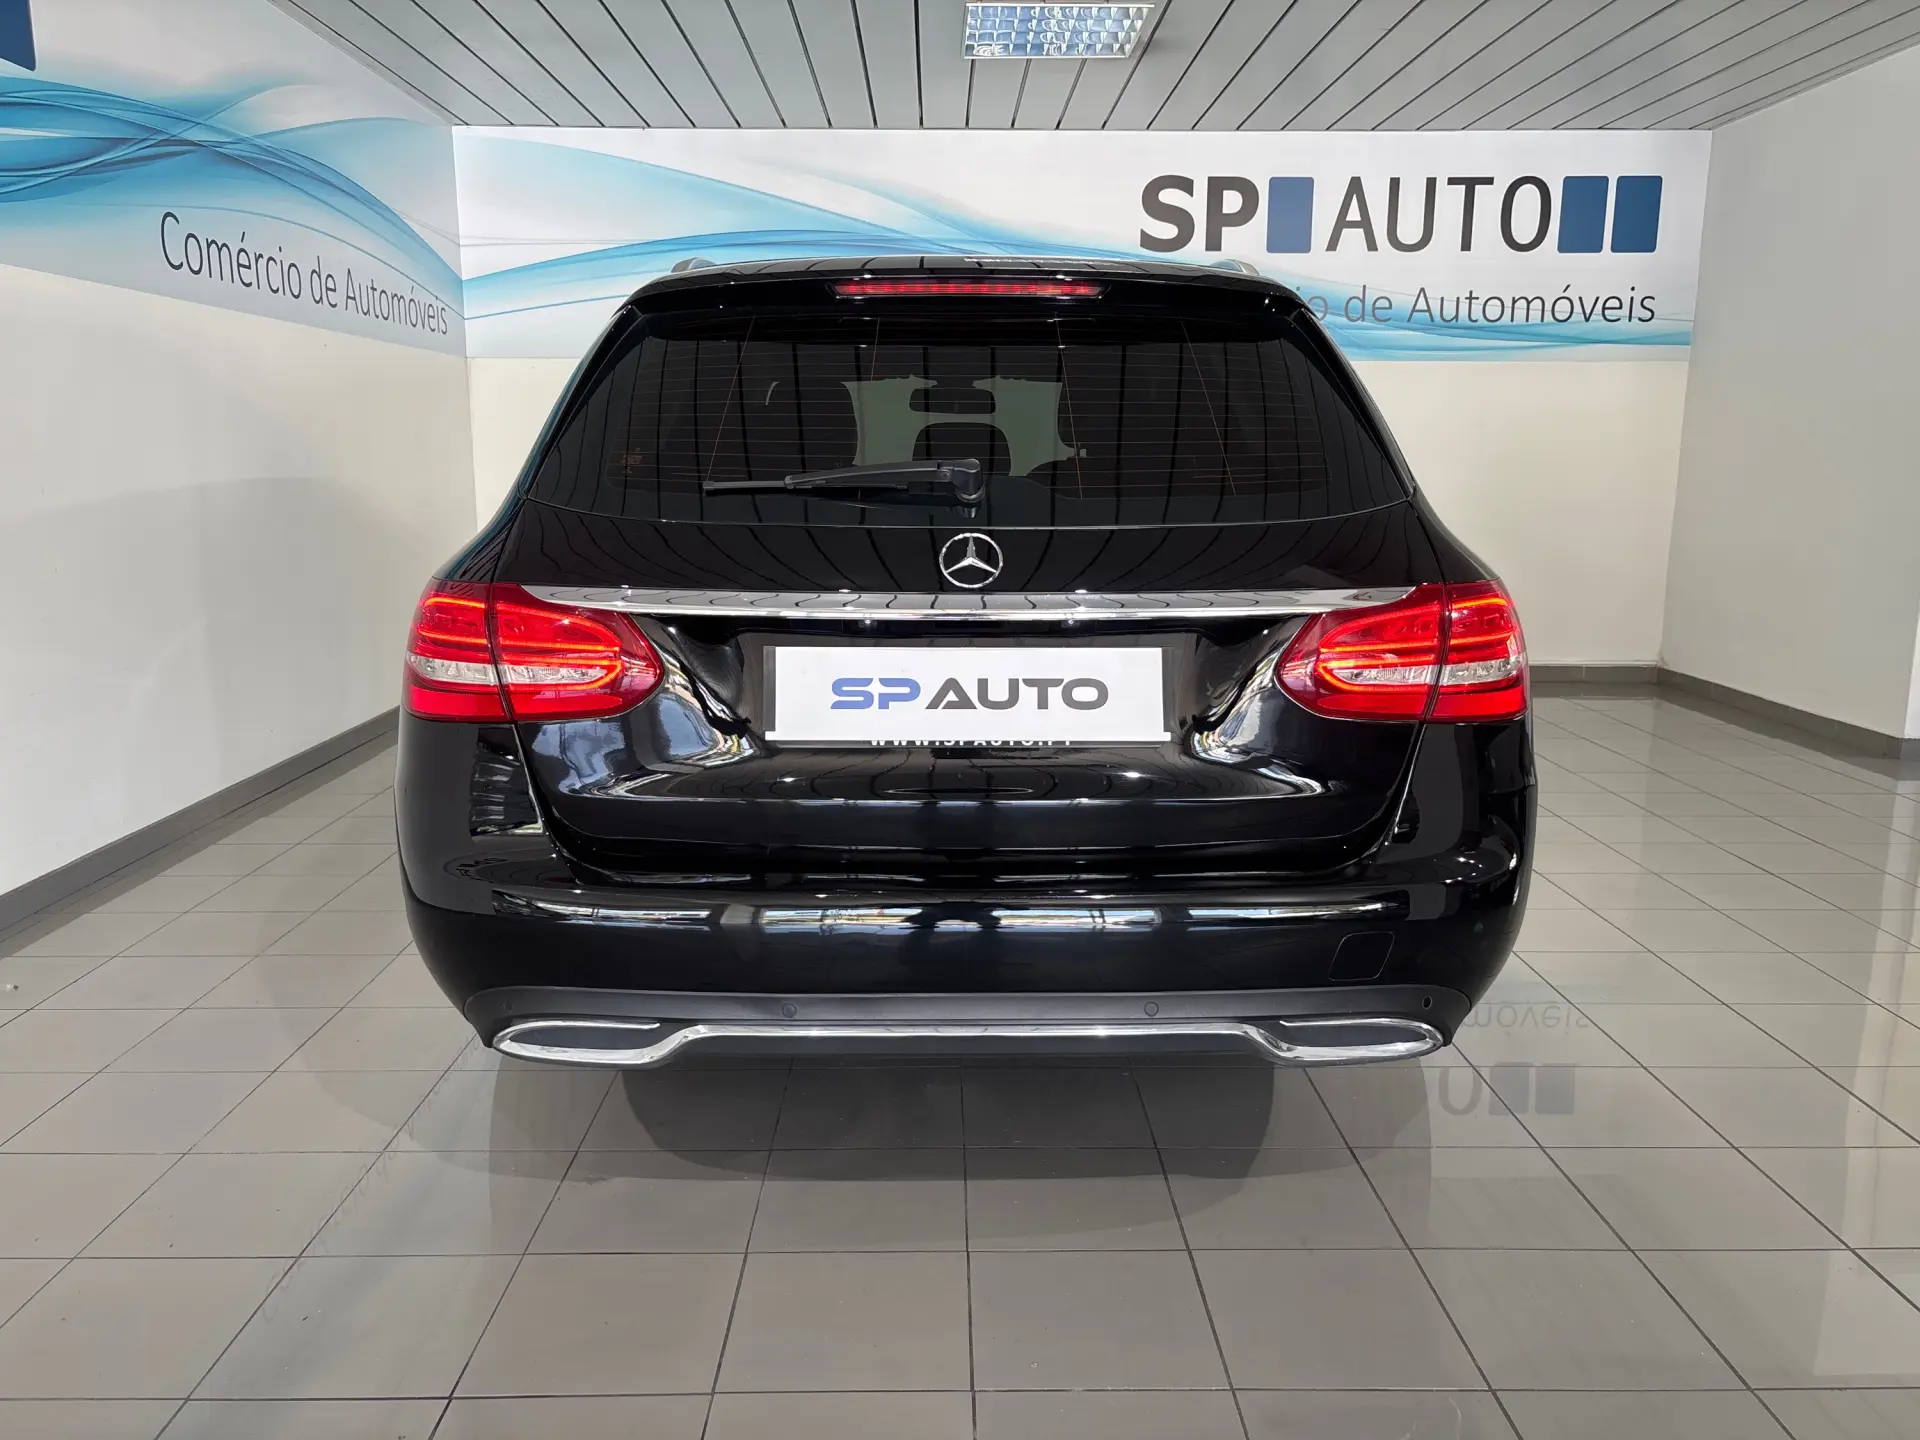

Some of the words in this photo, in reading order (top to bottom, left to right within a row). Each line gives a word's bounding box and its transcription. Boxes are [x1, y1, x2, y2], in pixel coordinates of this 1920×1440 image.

[1139, 174, 1260, 254] SP
[1325, 174, 1553, 254] AUTO
[160, 211, 302, 300] Comércio
[309, 255, 338, 309] de
[345, 267, 449, 336] Automóveis
[1345, 284, 1394, 323] de
[1406, 284, 1657, 324] Automóveis
